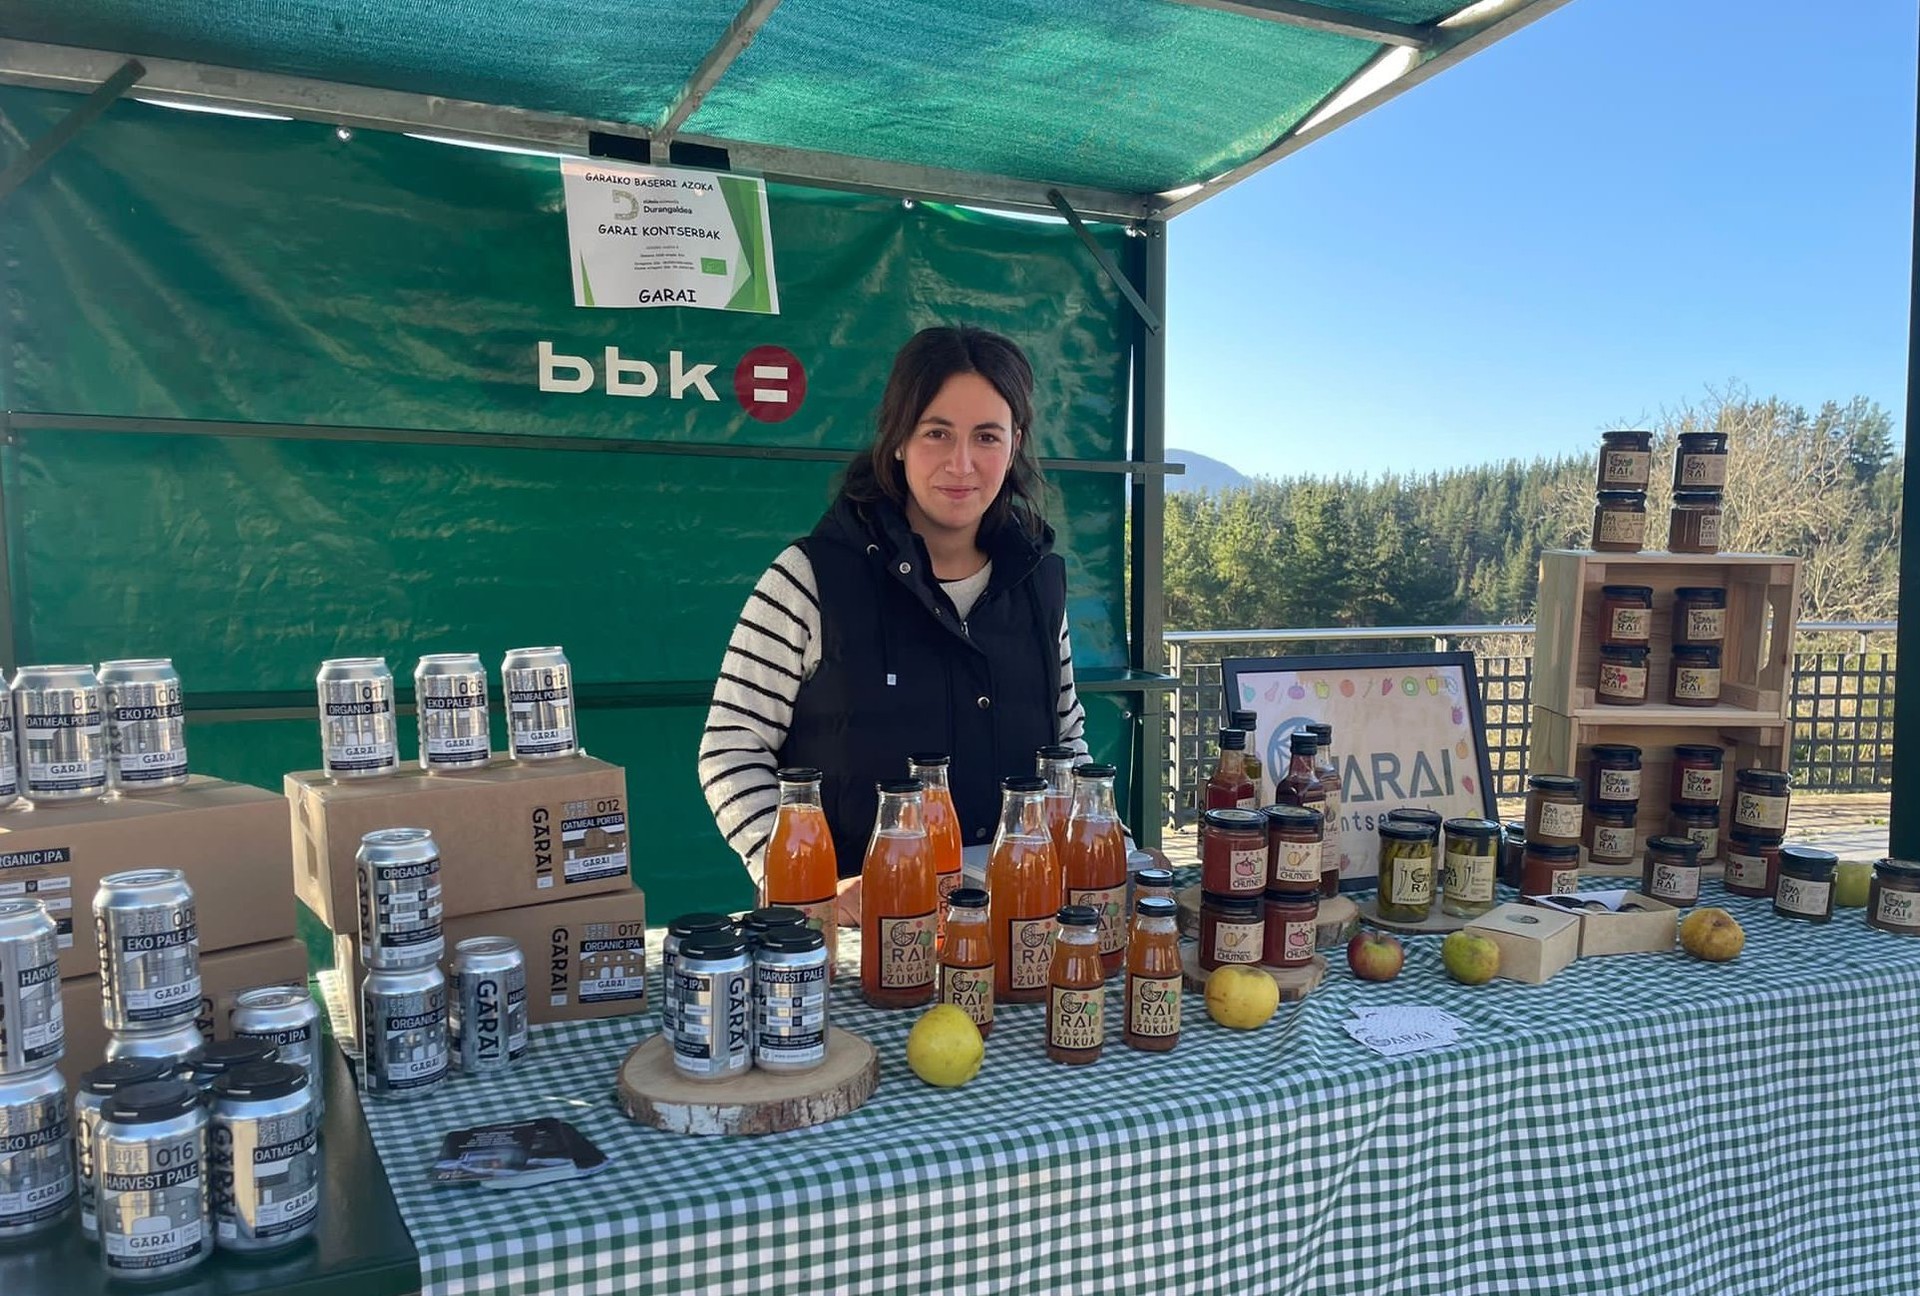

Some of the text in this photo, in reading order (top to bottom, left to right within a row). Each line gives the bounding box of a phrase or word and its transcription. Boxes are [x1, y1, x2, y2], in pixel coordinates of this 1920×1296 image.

[585, 172, 714, 191] GARAIKO BASERRI AZOKA
[643, 205, 693, 214] Durangaldea
[598, 224, 721, 240] GARAI KONTSERBAK
[638, 288, 697, 303] GARAI
[537, 341, 720, 401] bbk
[544, 672, 566, 687] 012
[362, 685, 385, 700] 017
[458, 680, 483, 695] 009
[72, 694, 98, 710] 012
[427, 695, 485, 708] EKO PALE ALE
[510, 691, 543, 701] OATMEAL
[119, 704, 183, 720] EKO PALE ALE
[328, 702, 387, 715] ORGANIC IPA
[26, 713, 100, 728] OATMEAL PORTER
[444, 739, 474, 748] GARAI
[530, 731, 559, 741] GARAI
[142, 752, 176, 764] GARAI
[345, 746, 377, 756] GARAI
[50, 763, 87, 775] GARAI
[596, 799, 620, 813] 012
[562, 814, 624, 831] OATMEAL PORTER
[532, 807, 553, 874] GARAI
[44, 850, 64, 863] IPA
[582, 856, 611, 868] GARAI
[383, 864, 430, 880] ORGANIC
[1656, 879, 1677, 890] RAI
[1883, 906, 1906, 917] RAI
[618, 923, 641, 937] 017
[127, 937, 154, 951] EKO
[156, 931, 185, 948] PALE
[584, 938, 641, 952] ORGANIC IPA
[550, 927, 569, 992] GARAI
[892, 948, 928, 963] RAI
[1022, 949, 1050, 964] RA
[760, 967, 824, 983] HARVEST PALE
[887, 973, 931, 985] ZUKUA
[154, 982, 191, 1000] GARAI
[597, 979, 626, 989] GARAI
[689, 979, 705, 990] IPA
[952, 992, 984, 1006] RAI
[729, 977, 746, 1052] GARAI
[1140, 1003, 1172, 1016] RAI
[391, 1012, 437, 1030] ORGANIC
[476, 979, 499, 1060] GARAI
[1060, 1014, 1093, 1028] RAI
[1136, 1023, 1175, 1033] ZUKUA
[289, 1029, 307, 1044] IPA
[1056, 1036, 1096, 1047] ZUKUA
[410, 1058, 440, 1073] GARAI
[29, 1127, 58, 1146] PALE
[155, 1141, 194, 1167] 016
[254, 1140, 303, 1162] OATMEAL
[104, 1163, 198, 1190] HARVEST PALE
[214, 1125, 237, 1218] GARAI
[129, 1231, 175, 1249] GARAI
